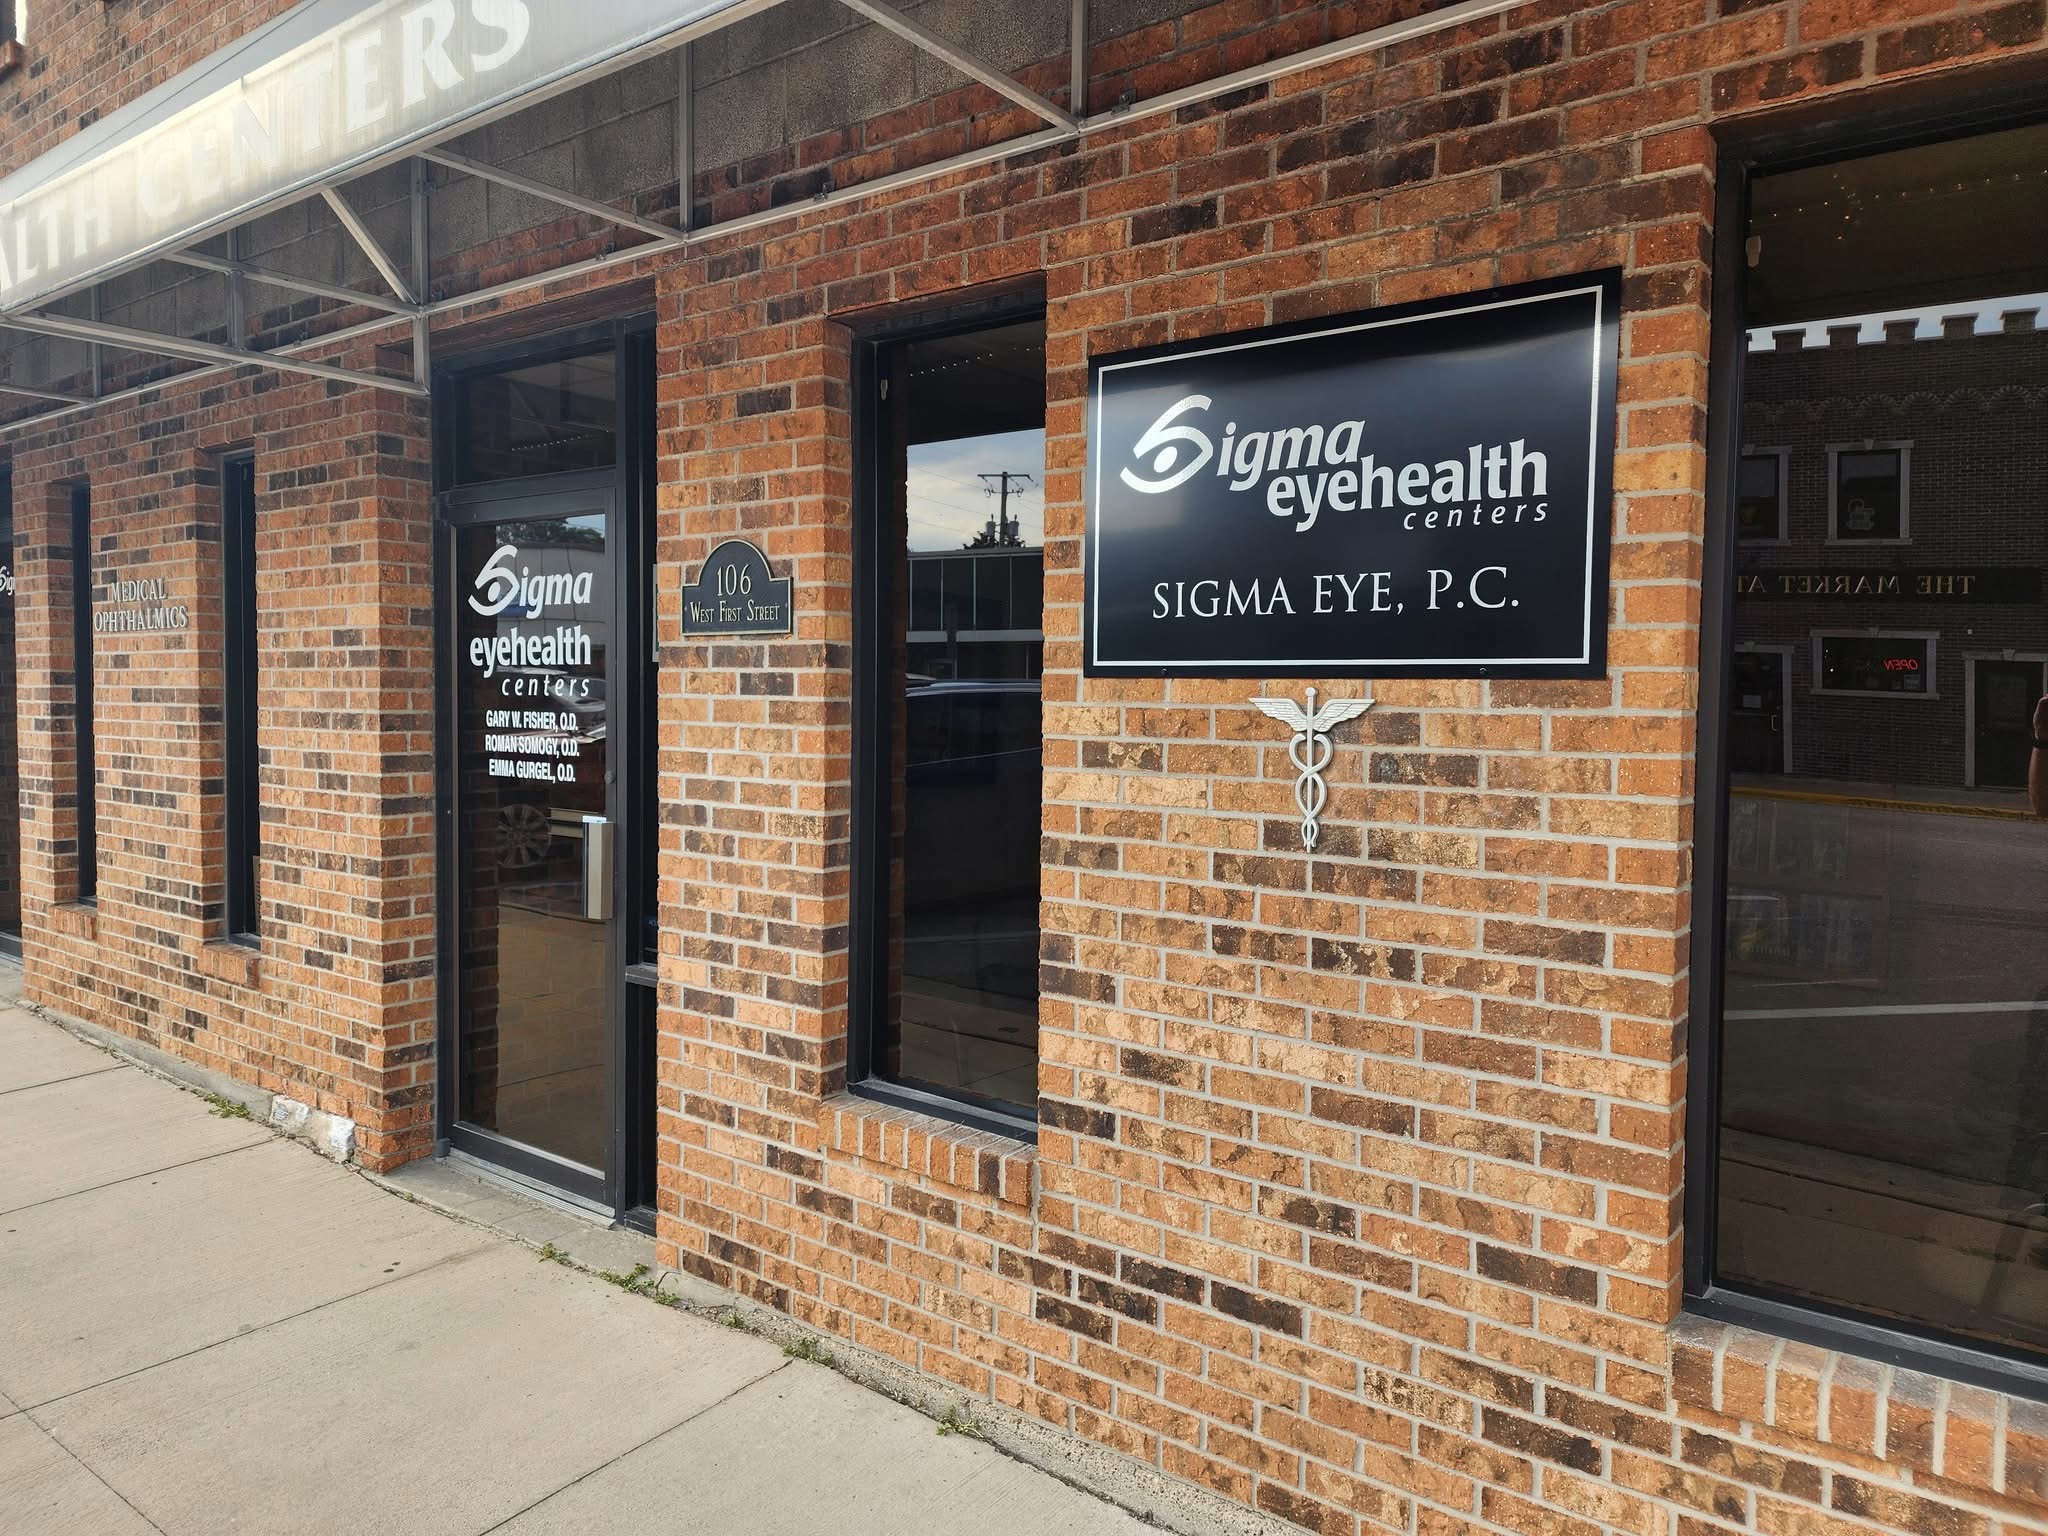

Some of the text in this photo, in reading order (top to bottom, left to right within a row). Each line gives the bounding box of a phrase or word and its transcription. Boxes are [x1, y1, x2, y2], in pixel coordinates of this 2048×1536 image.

[140, 0, 531, 217] CENTERS
[1119, 394, 1366, 494] Sigma
[1266, 438, 1549, 532] eyehealth
[1403, 500, 1549, 531] centers
[110, 578, 168, 602] MEDICAL
[467, 544, 593, 619] Sigma
[717, 564, 752, 596] 106
[1152, 566, 1520, 619] SIGMA EYE, P.C.
[94, 605, 189, 632] OPHTHALMICS
[690, 598, 780, 623] WEST FIRST STREET
[470, 625, 592, 678] eyehealth
[501, 674, 590, 697] centers
[486, 710, 579, 733] GARY W. FISHER, O.D.
[485, 734, 580, 759] ROMAN SOMOGY, O.D.
[488, 759, 576, 784] EMMA GURGEL, O.D.
